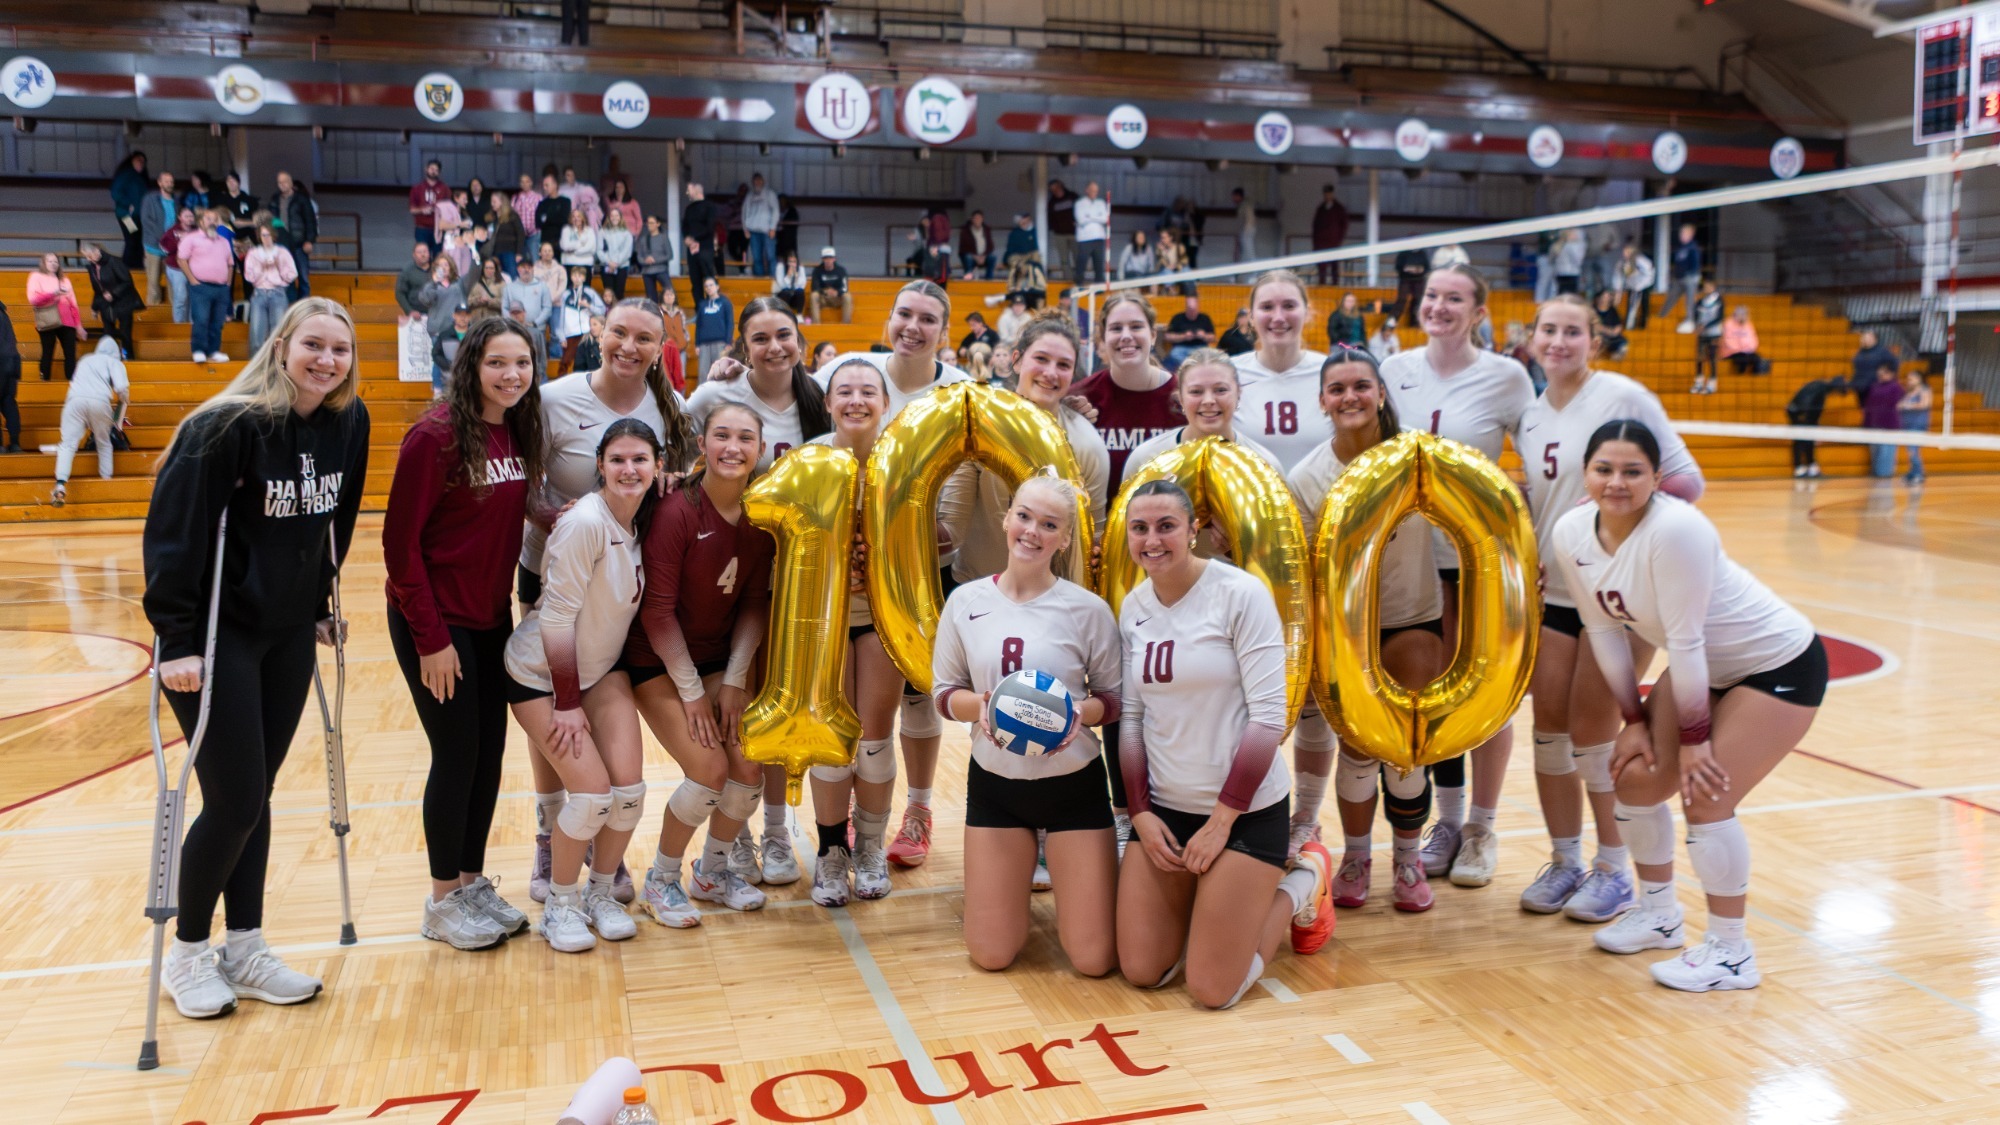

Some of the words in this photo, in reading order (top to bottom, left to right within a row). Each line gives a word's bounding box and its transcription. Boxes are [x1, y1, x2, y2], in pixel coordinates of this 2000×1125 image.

[608, 97, 645, 113] MAC
[1264, 401, 1298, 435] 18
[1543, 441, 1560, 480] 5
[716, 556, 739, 594] 4
[1001, 637, 1024, 678] 8
[1142, 639, 1175, 684] 10
